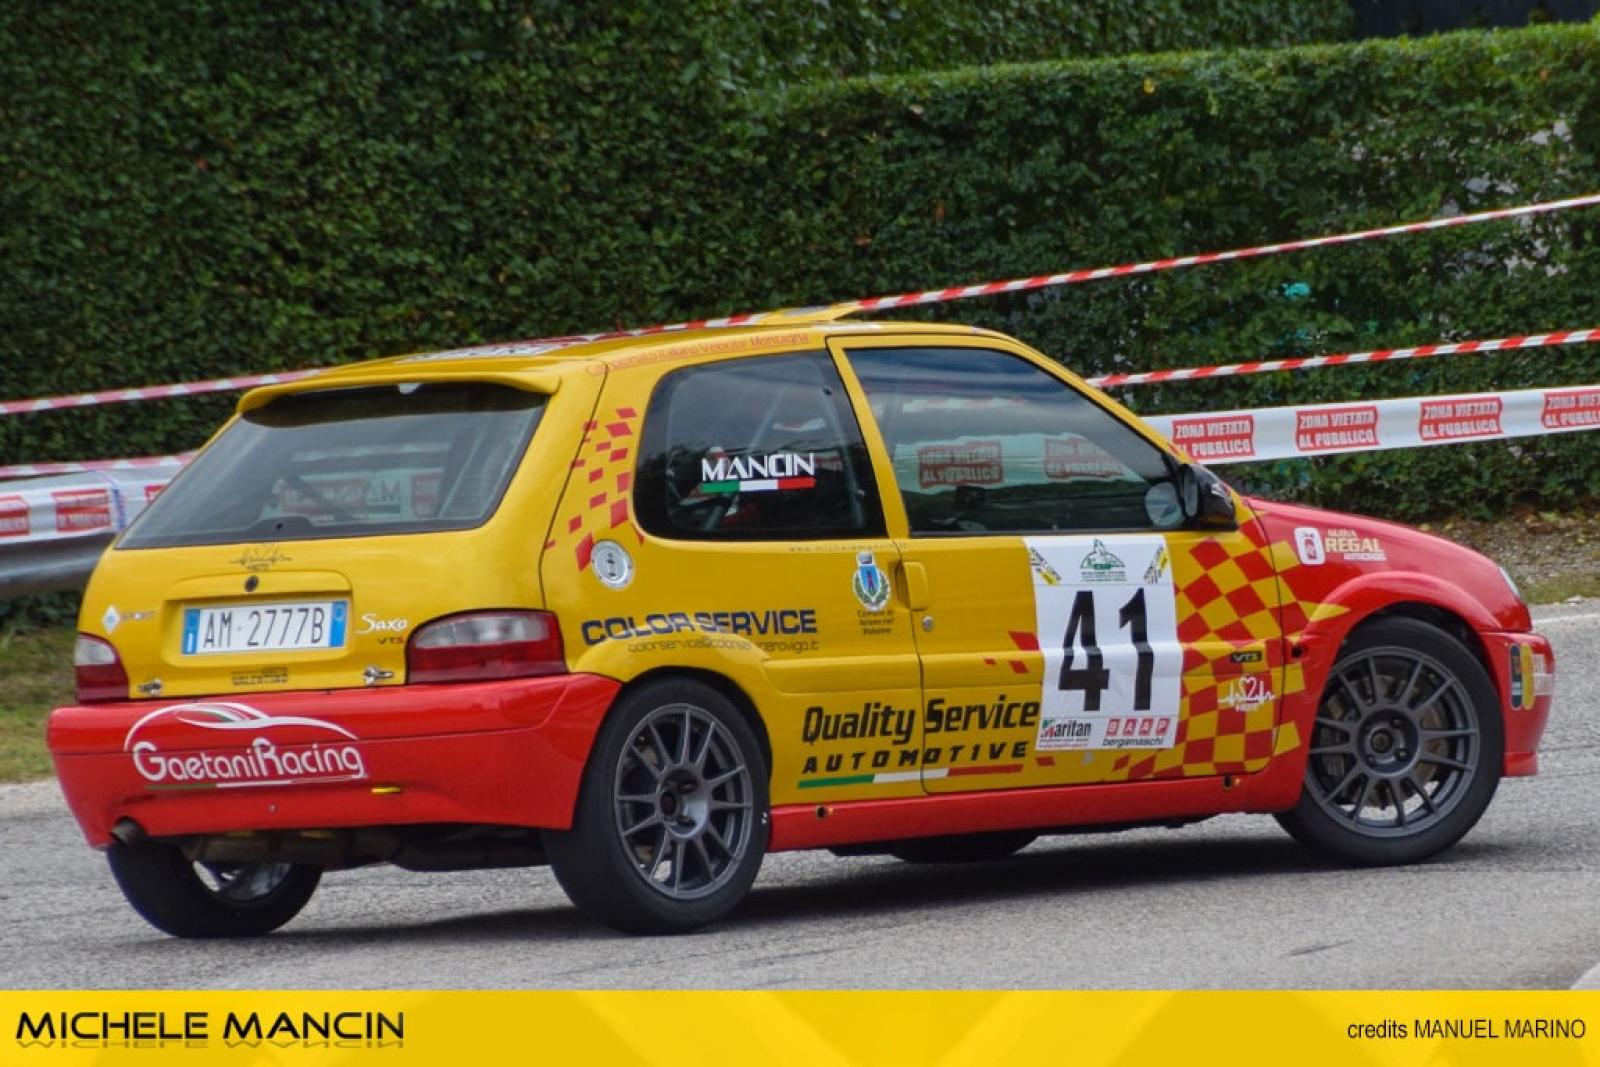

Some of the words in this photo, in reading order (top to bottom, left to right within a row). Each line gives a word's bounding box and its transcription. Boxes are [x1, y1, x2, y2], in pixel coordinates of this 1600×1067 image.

[1300, 414, 1328, 428] ZONA
[1331, 411, 1374, 427] VIETATA
[1424, 405, 1452, 418] ZONA
[1455, 402, 1498, 416] VIETATA
[1176, 424, 1204, 438] ZONA
[1207, 420, 1250, 436] VIETATA
[1300, 434, 1314, 447] AL
[1315, 430, 1375, 446] PUBBLICO
[1422, 424, 1435, 437] AL
[1438, 419, 1497, 435] PUBBLICO
[1192, 440, 1250, 456] PUBBLICO
[702, 453, 815, 481] MANCIN
[1325, 538, 1384, 553] REGAL
[203, 610, 232, 649] AM
[357, 613, 408, 634] Saxo
[581, 611, 695, 646] COLOR
[694, 609, 817, 637] SERVICE
[1058, 587, 1154, 711] 41
[802, 702, 915, 746] Quality
[924, 695, 1040, 733] Service
[132, 738, 366, 781] GaetaniRacing
[802, 741, 1029, 774] AUTOMOTIVE
